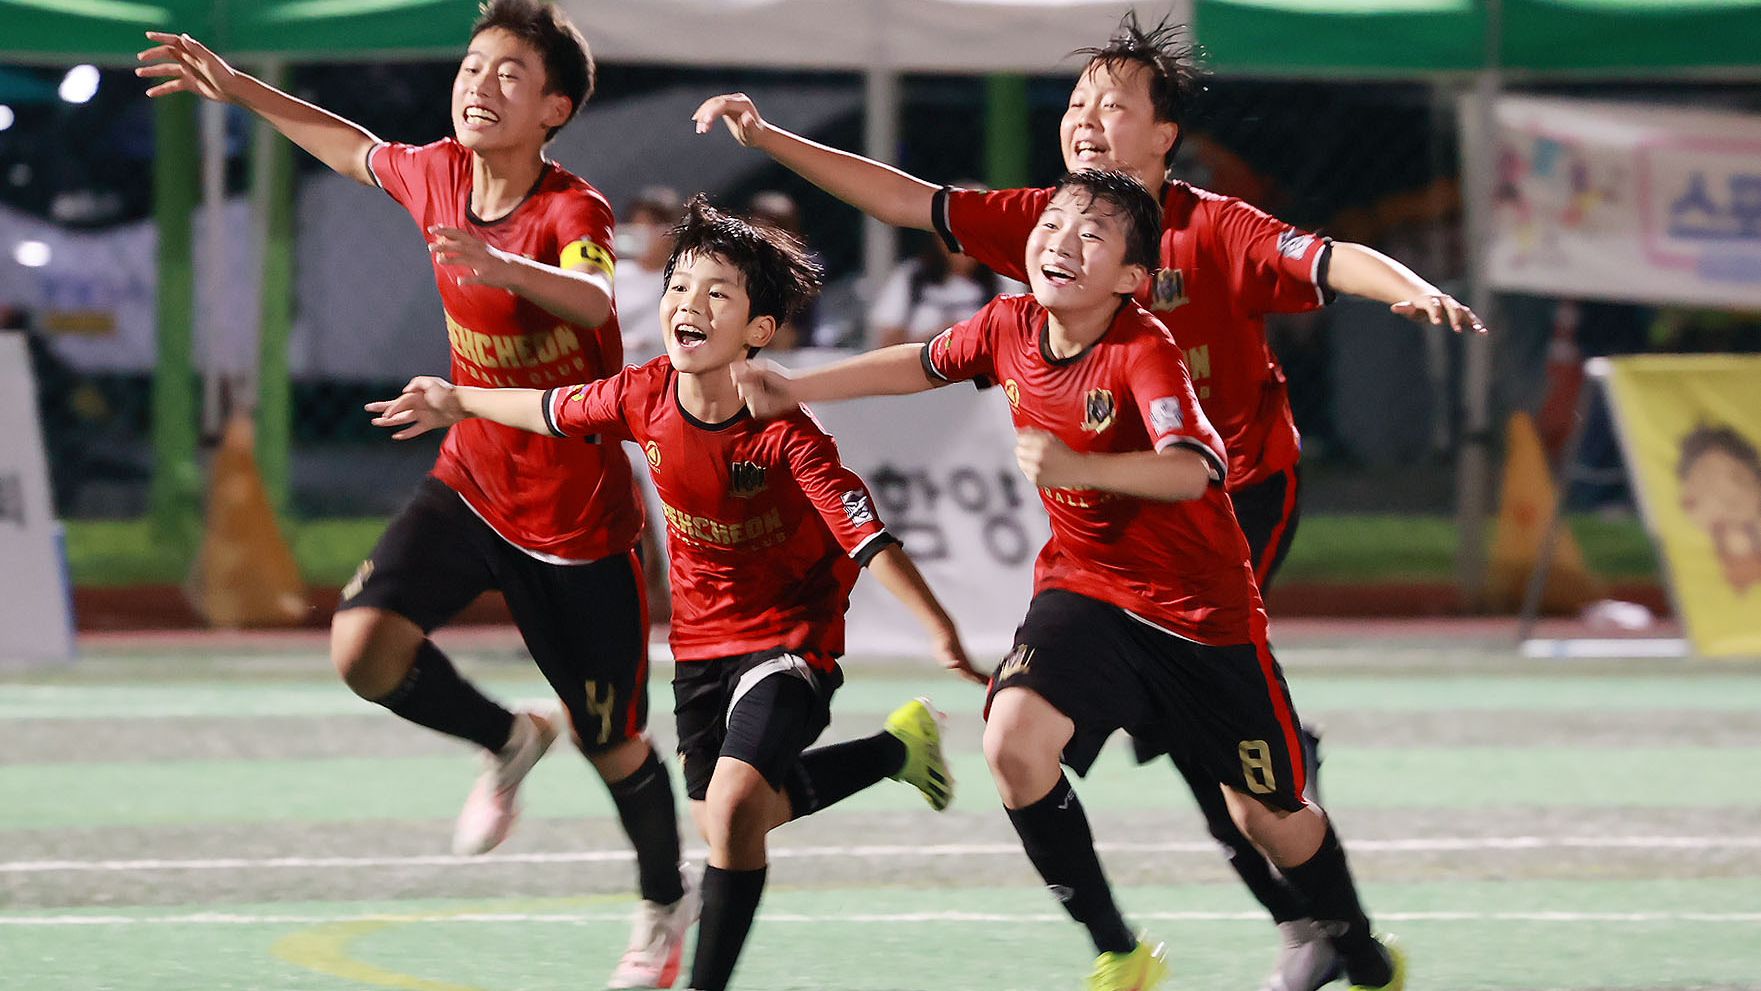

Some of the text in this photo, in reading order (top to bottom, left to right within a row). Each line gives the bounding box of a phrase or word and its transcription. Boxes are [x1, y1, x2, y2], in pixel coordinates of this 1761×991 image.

[867, 461, 1031, 567] 함양
[585, 680, 614, 744] 4
[1238, 739, 1276, 794] 8
